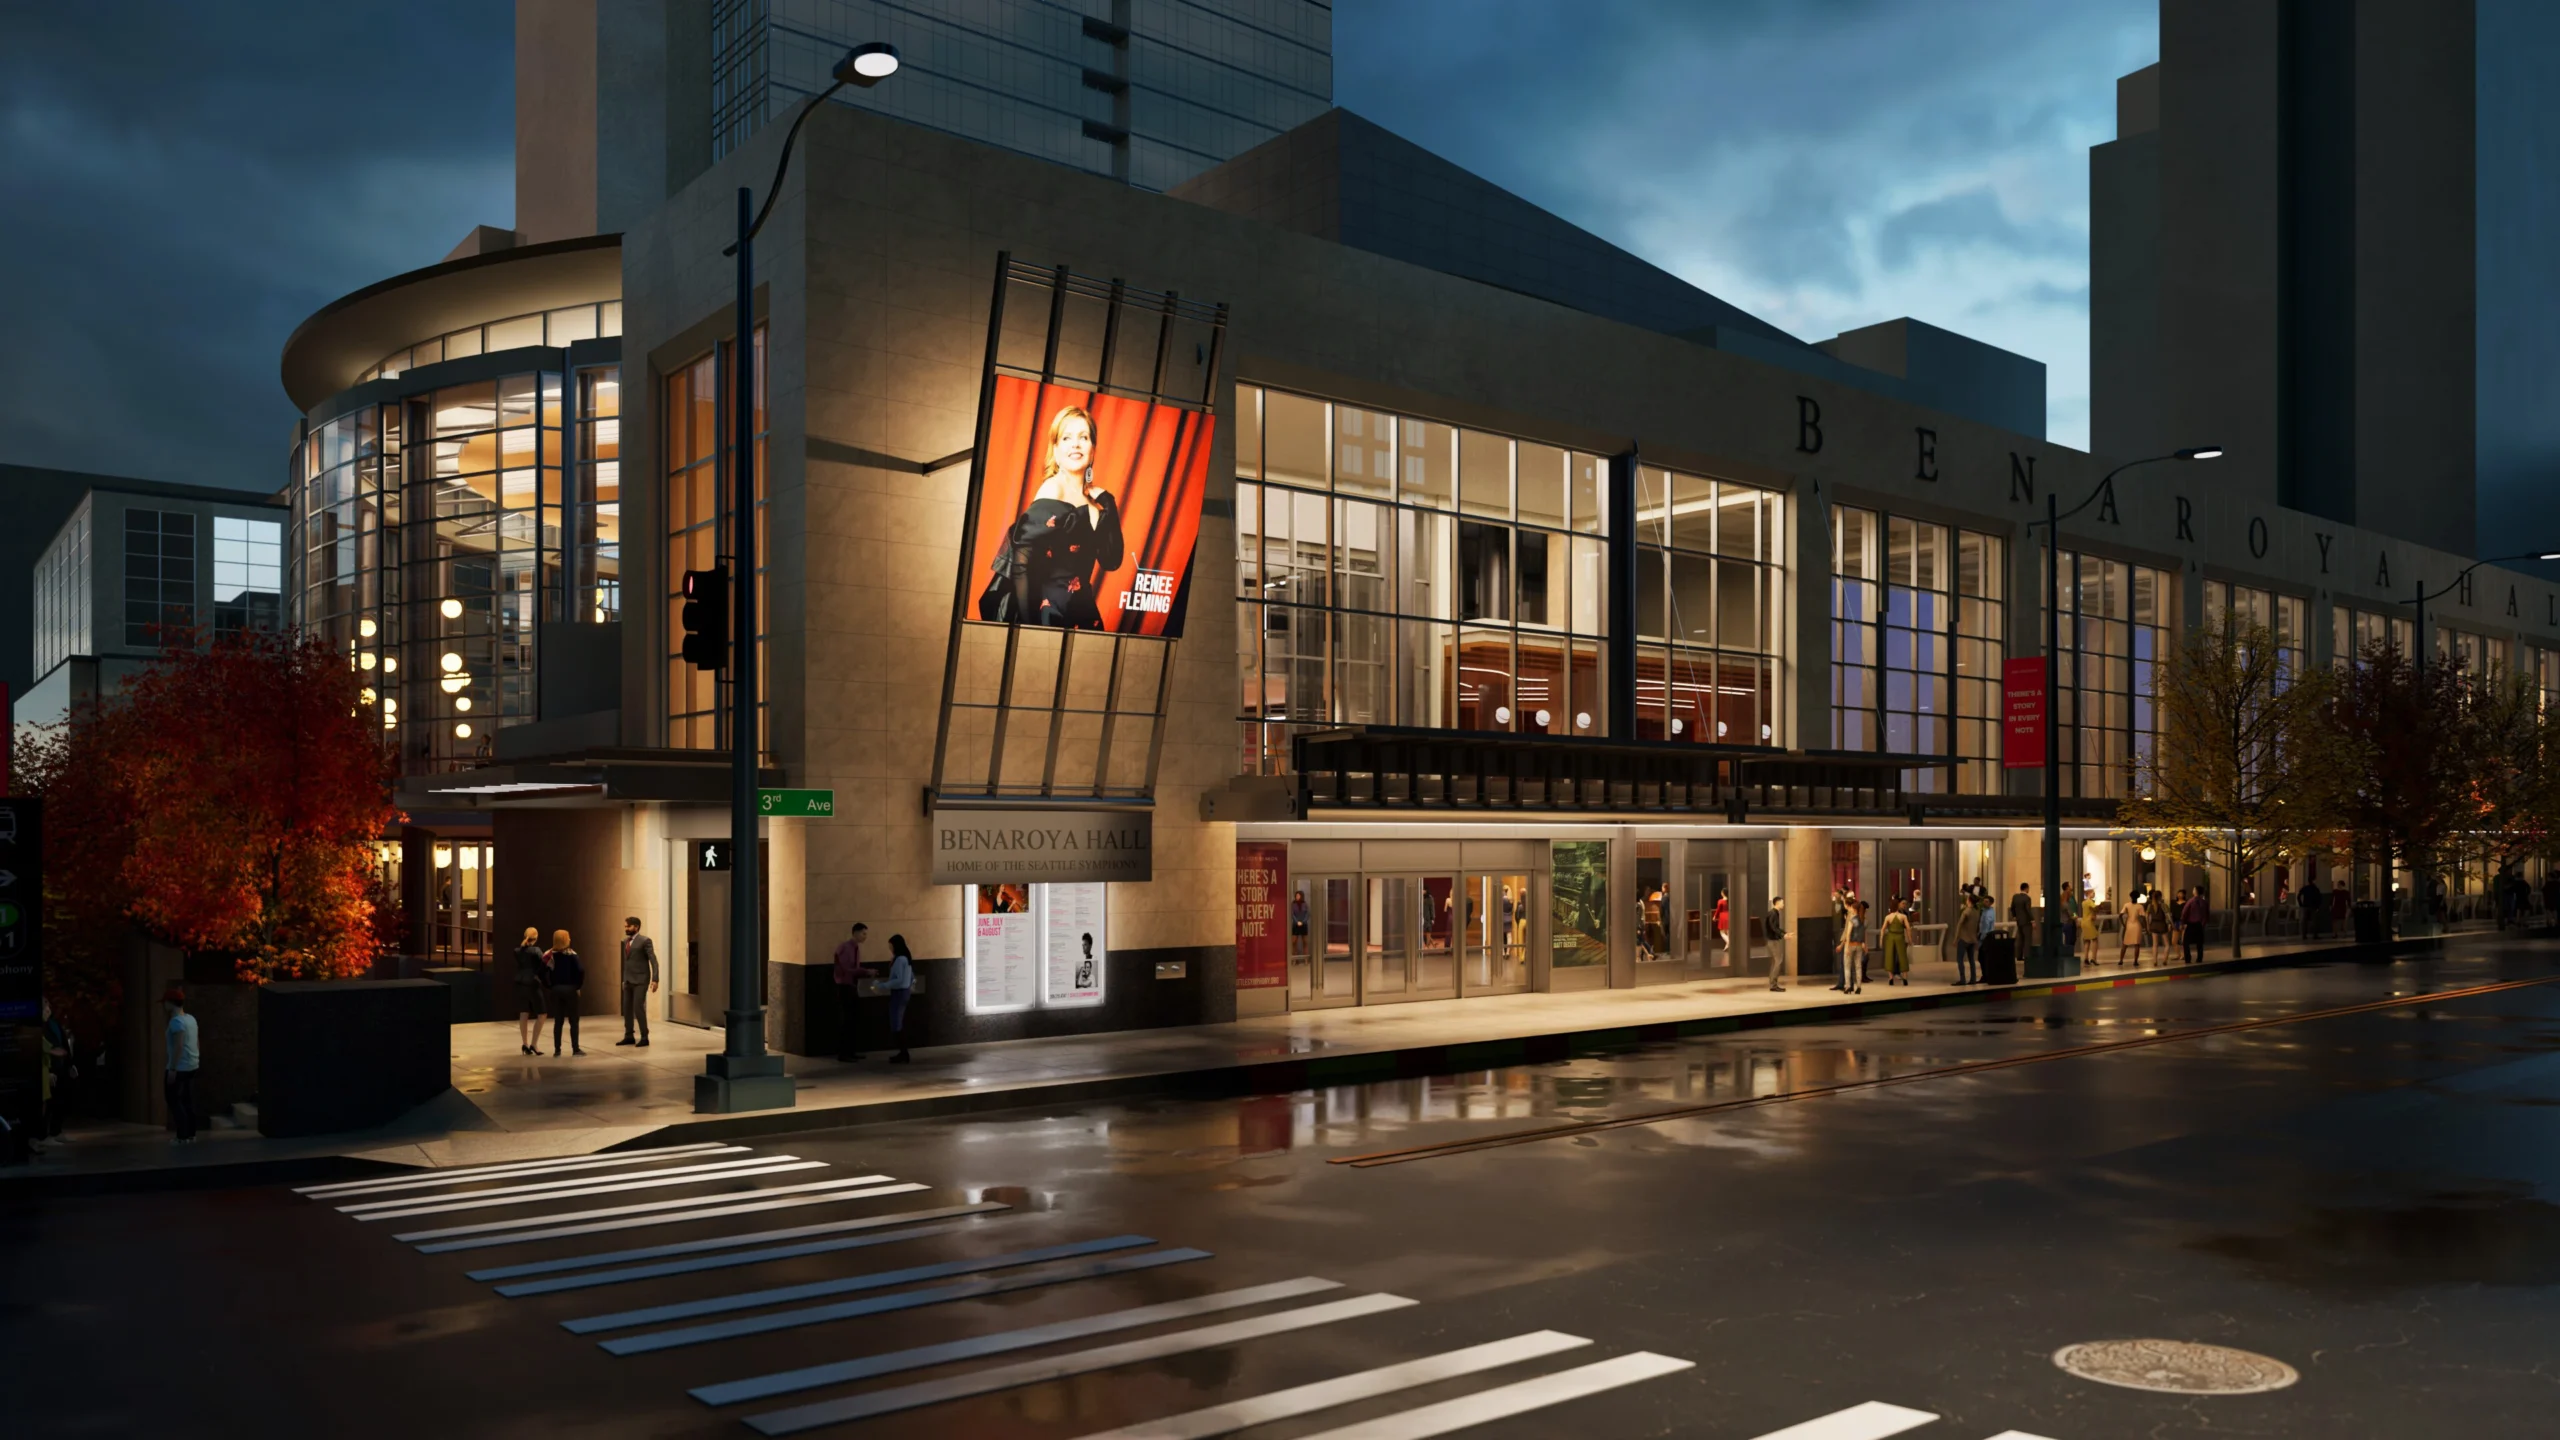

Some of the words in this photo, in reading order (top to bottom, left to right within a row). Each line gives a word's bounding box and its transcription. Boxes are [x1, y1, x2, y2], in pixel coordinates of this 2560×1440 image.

[1796, 395, 2391, 588] BENAROYA
[1135, 573, 1174, 594] RENEE
[1119, 591, 1170, 613] FLEMING
[2012, 702, 2036, 710] STORY
[2017, 714, 2041, 722] EVERY
[762, 794, 782, 811] 3rd
[807, 799, 831, 811] Ave
[940, 829, 1078, 850] BENAROYA
[1086, 829, 1147, 850] HALL
[947, 861, 982, 872] HOME
[984, 861, 1000, 871] OF
[1003, 860, 1025, 871] THE
[1028, 860, 1076, 871] SEATTLE
[1079, 860, 1138, 871] SYMPHONY
[1271, 869, 1277, 885] A
[1240, 886, 1268, 902] STORY
[1237, 904, 1244, 920] N
[1247, 904, 1275, 920] EVERY
[992, 917, 1003, 926] JULY
[1242, 921, 1267, 937] NOTE.
[982, 927, 1001, 936] AUGUST
